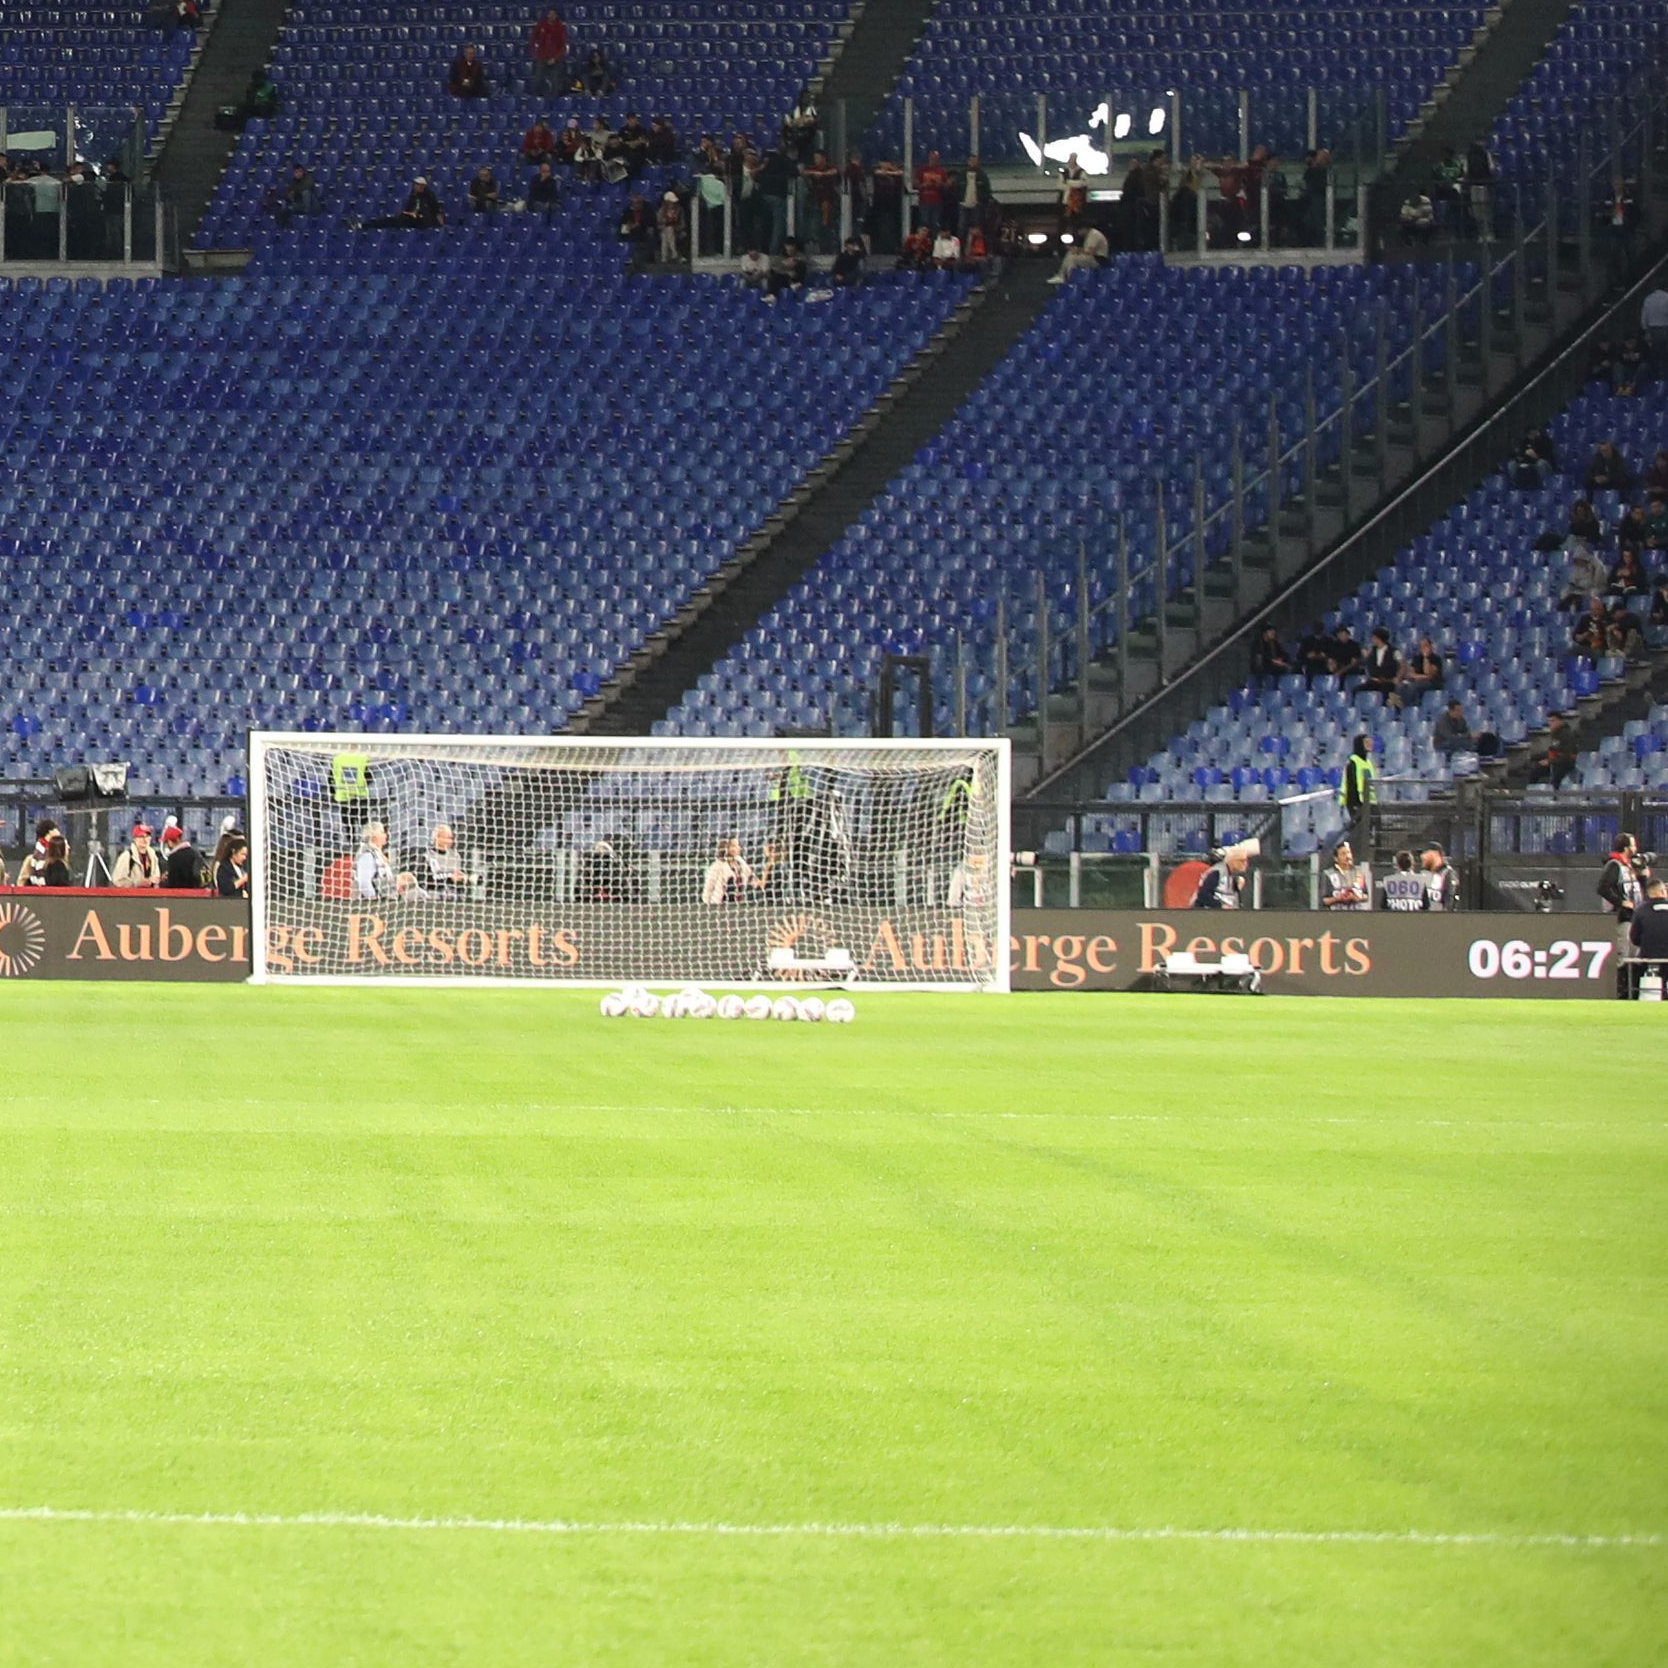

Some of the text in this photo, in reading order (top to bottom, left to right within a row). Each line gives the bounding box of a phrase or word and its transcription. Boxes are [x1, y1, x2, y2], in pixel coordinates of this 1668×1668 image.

[66, 906, 581, 974] Auberge Resorts
[1468, 939, 1613, 979] 06:27
